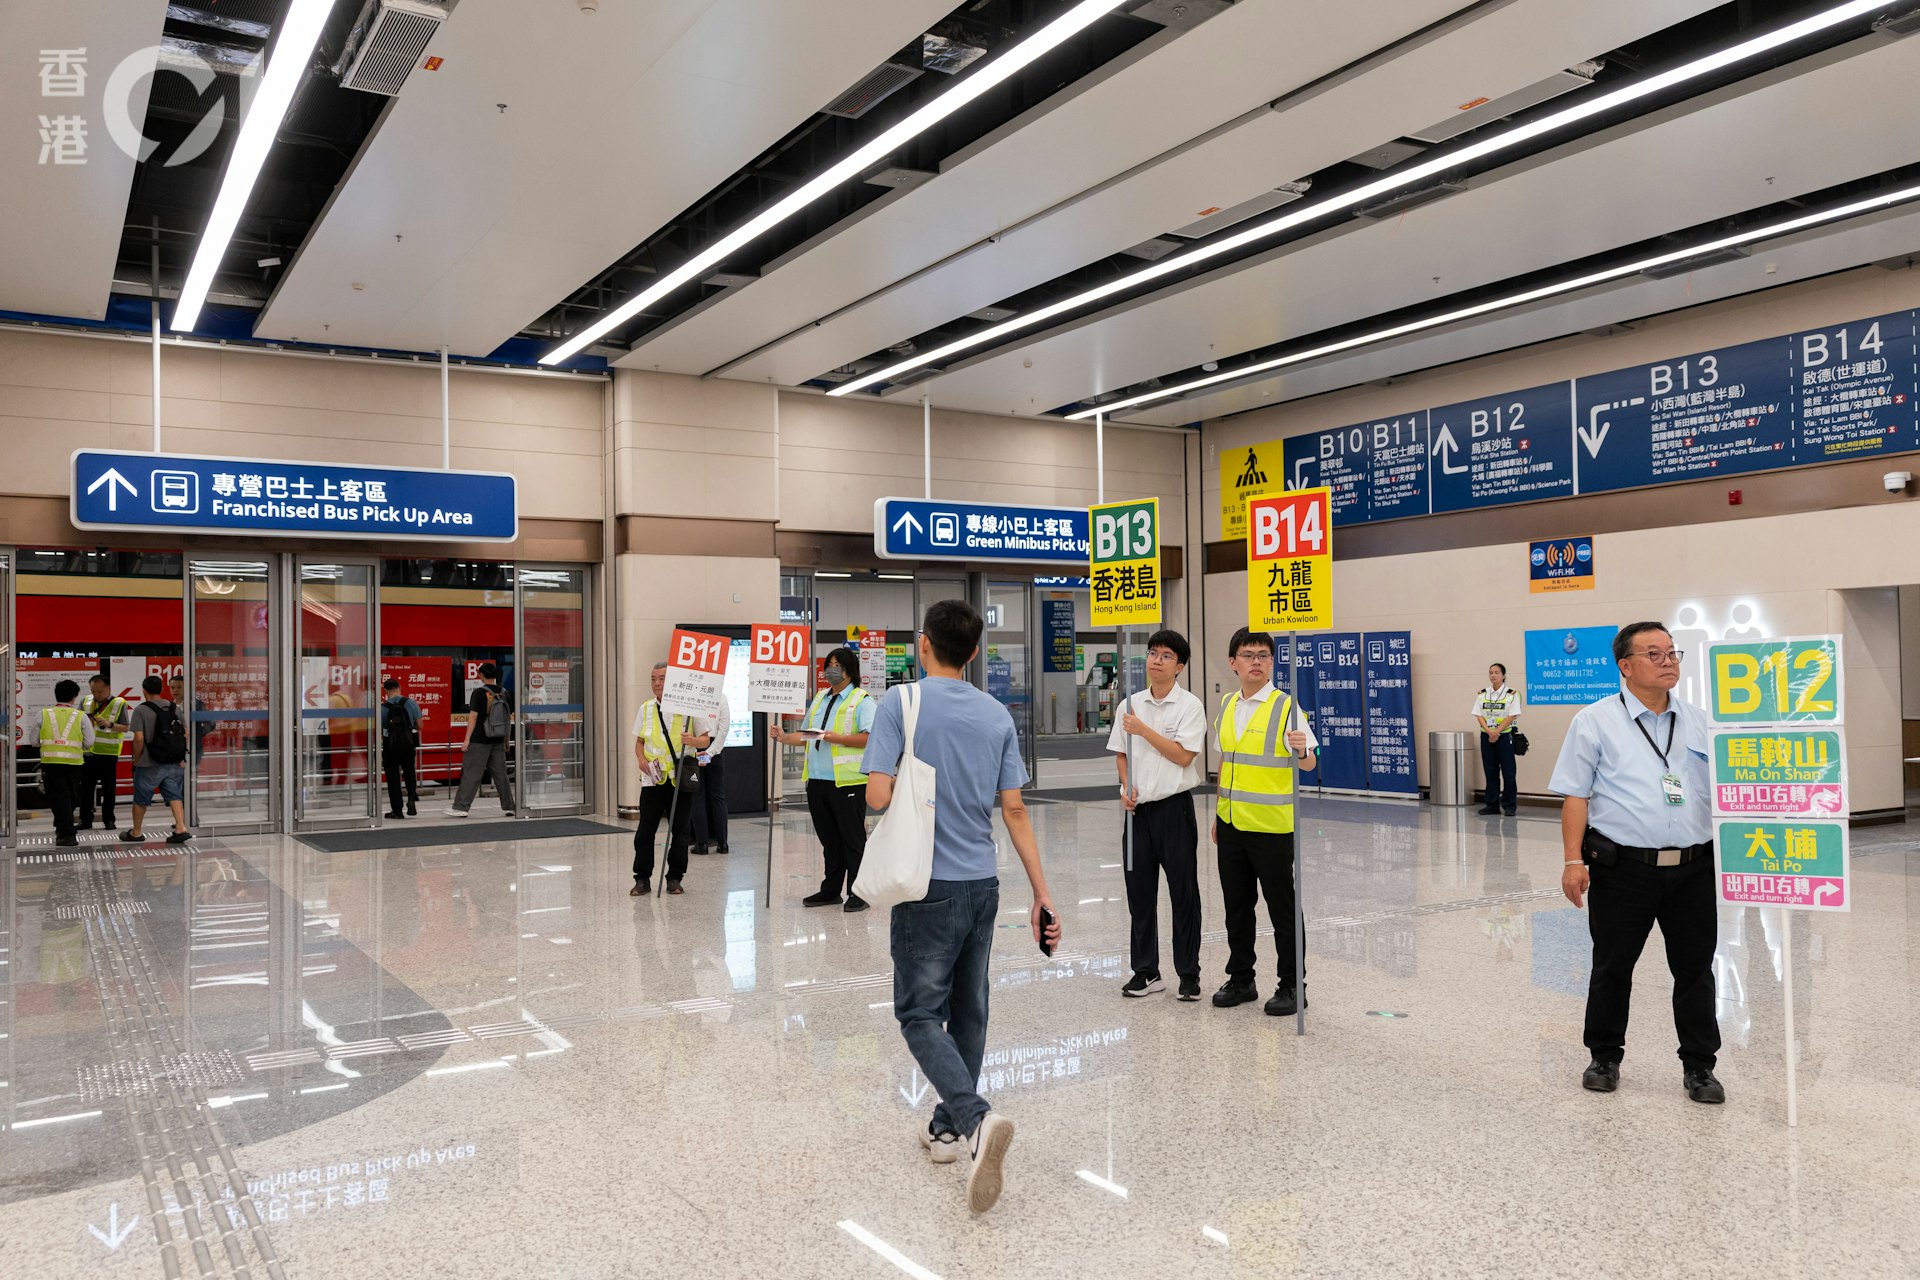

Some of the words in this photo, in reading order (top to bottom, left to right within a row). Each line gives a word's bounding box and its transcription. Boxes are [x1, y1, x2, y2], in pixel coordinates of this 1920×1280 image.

[1803, 322, 1884, 368] B14
[1651, 355, 1719, 396] B13
[1830, 380, 1861, 391] (Olympic
[1863, 373, 1894, 385] Avenue)
[1471, 403, 1525, 438] B12
[1804, 428, 1815, 436] Kai
[1831, 423, 1856, 432] Sports
[1374, 417, 1416, 449] B11
[1804, 437, 1822, 445] Sung
[1823, 434, 1844, 442] Wong
[1859, 427, 1886, 437] Station
[1320, 428, 1363, 459] B10
[1374, 443, 1424, 462] 天富巴士總站
[1730, 448, 1747, 456] Point
[212, 473, 388, 504] 專營巴士上客區
[212, 498, 319, 520] Franchised
[324, 502, 358, 522] Bus
[362, 502, 400, 524] Pick
[404, 505, 429, 527] Up
[432, 505, 473, 526] Area
[966, 515, 1073, 537] 專線小巴上客區
[1096, 509, 1152, 559] B13
[1255, 500, 1323, 556] B14
[966, 535, 1002, 549] Green
[1004, 537, 1051, 550] Minibus
[1053, 539, 1075, 551] Pick
[1093, 564, 1157, 602] 香港島
[1268, 560, 1312, 588] 九龍
[1094, 604, 1112, 614] Hong
[1114, 604, 1132, 613] Kong
[1134, 602, 1157, 611] Island
[1269, 587, 1312, 615] 市區
[1263, 616, 1285, 625] Urban
[1287, 614, 1318, 624] Kowloon
[756, 629, 803, 663] B10
[1298, 642, 1312, 651] 城巴
[1340, 640, 1355, 650] 城巴
[1390, 639, 1405, 649] 城巴
[677, 636, 722, 671] B11
[1296, 656, 1314, 667] B15
[1339, 654, 1359, 666] B14
[1388, 653, 1409, 666] B13
[332, 665, 361, 685] B11
[408, 674, 425, 682] 元朗
[1716, 649, 1834, 714] B12
[1534, 684, 1545, 692] you
[1546, 683, 1566, 692] require
[1567, 682, 1586, 690] police
[1532, 694, 1550, 703] please
[317, 721, 326, 732] 4
[1727, 737, 1827, 768] 馬鞍山
[1735, 769, 1756, 781] Ma
[1760, 768, 1780, 781] On
[1784, 768, 1821, 781] Shan
[1721, 786, 1806, 804] 出門口右轉
[1780, 802, 1799, 812] right
[1744, 827, 1817, 860] 大埔
[1760, 859, 1780, 871] Tai
[1783, 860, 1802, 872] Po
[1726, 875, 1810, 895] 出門口右轉
[1766, 894, 1781, 902] turn
[1783, 894, 1803, 903] right
